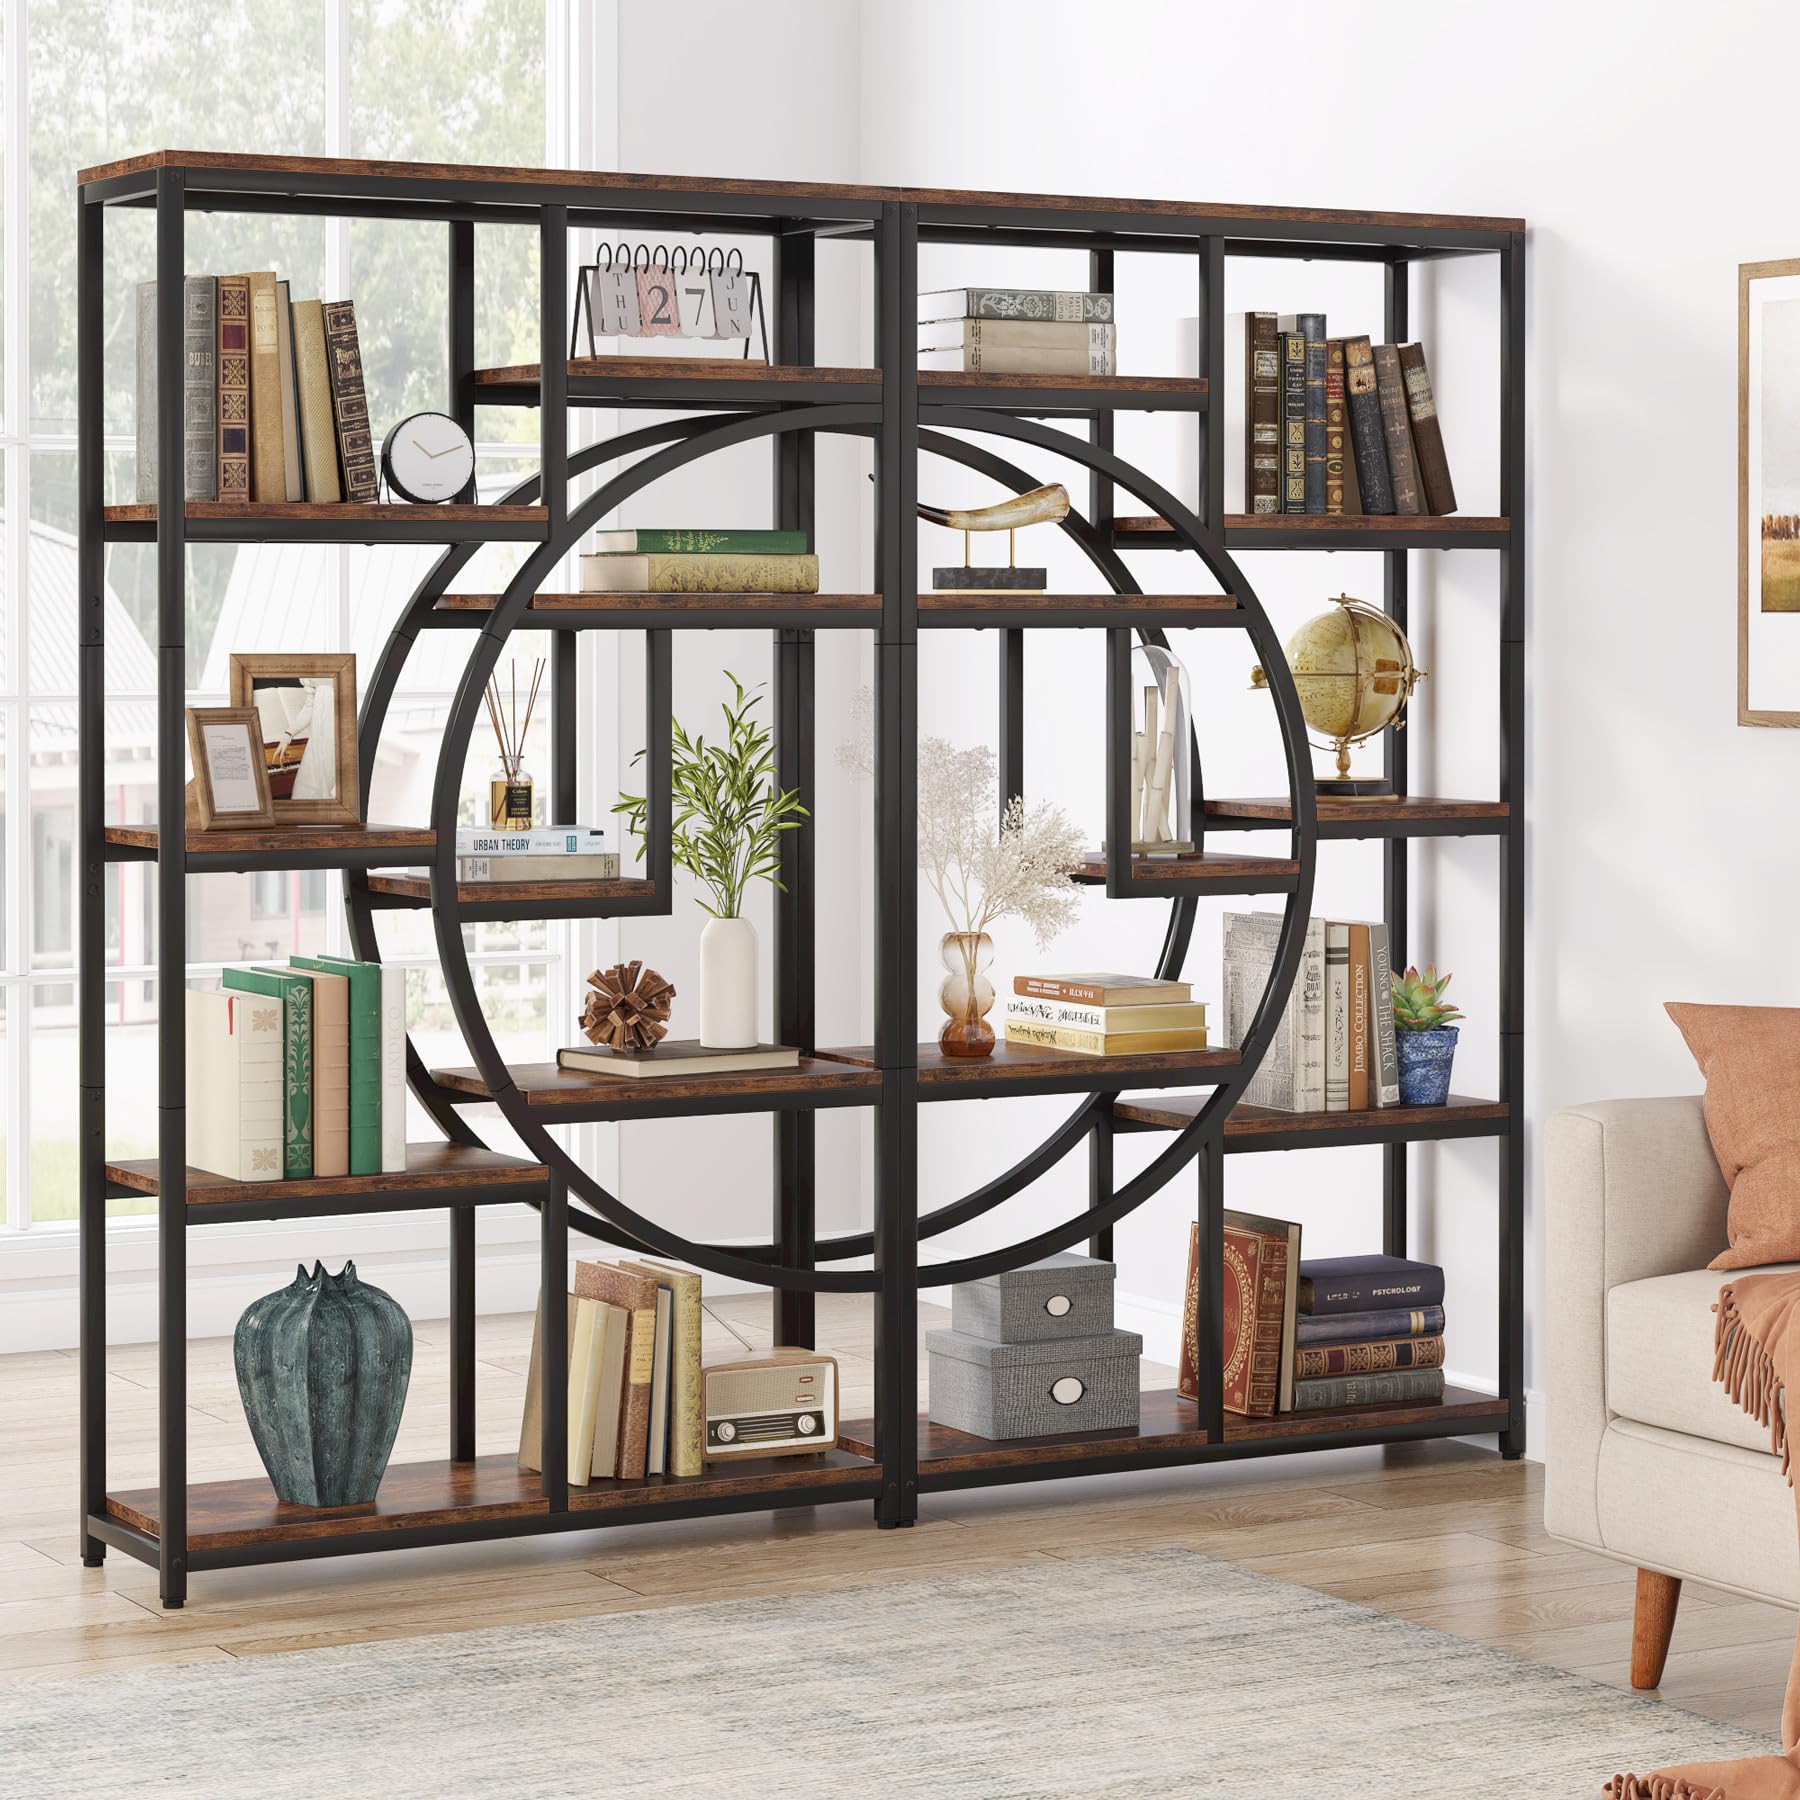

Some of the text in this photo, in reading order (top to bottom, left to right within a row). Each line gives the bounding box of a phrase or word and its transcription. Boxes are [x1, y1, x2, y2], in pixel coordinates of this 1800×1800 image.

[612, 272, 629, 331] THU
[726, 276, 743, 334] JUN
[473, 839, 499, 851] URBAN
[502, 838, 531, 850] THEORY
[1354, 964, 1366, 1072] JUMBO COLLECTION
[1377, 946, 1396, 1071] YOUNG THE SHACK
[1372, 1285, 1421, 1296] PSYCHOLOGY
